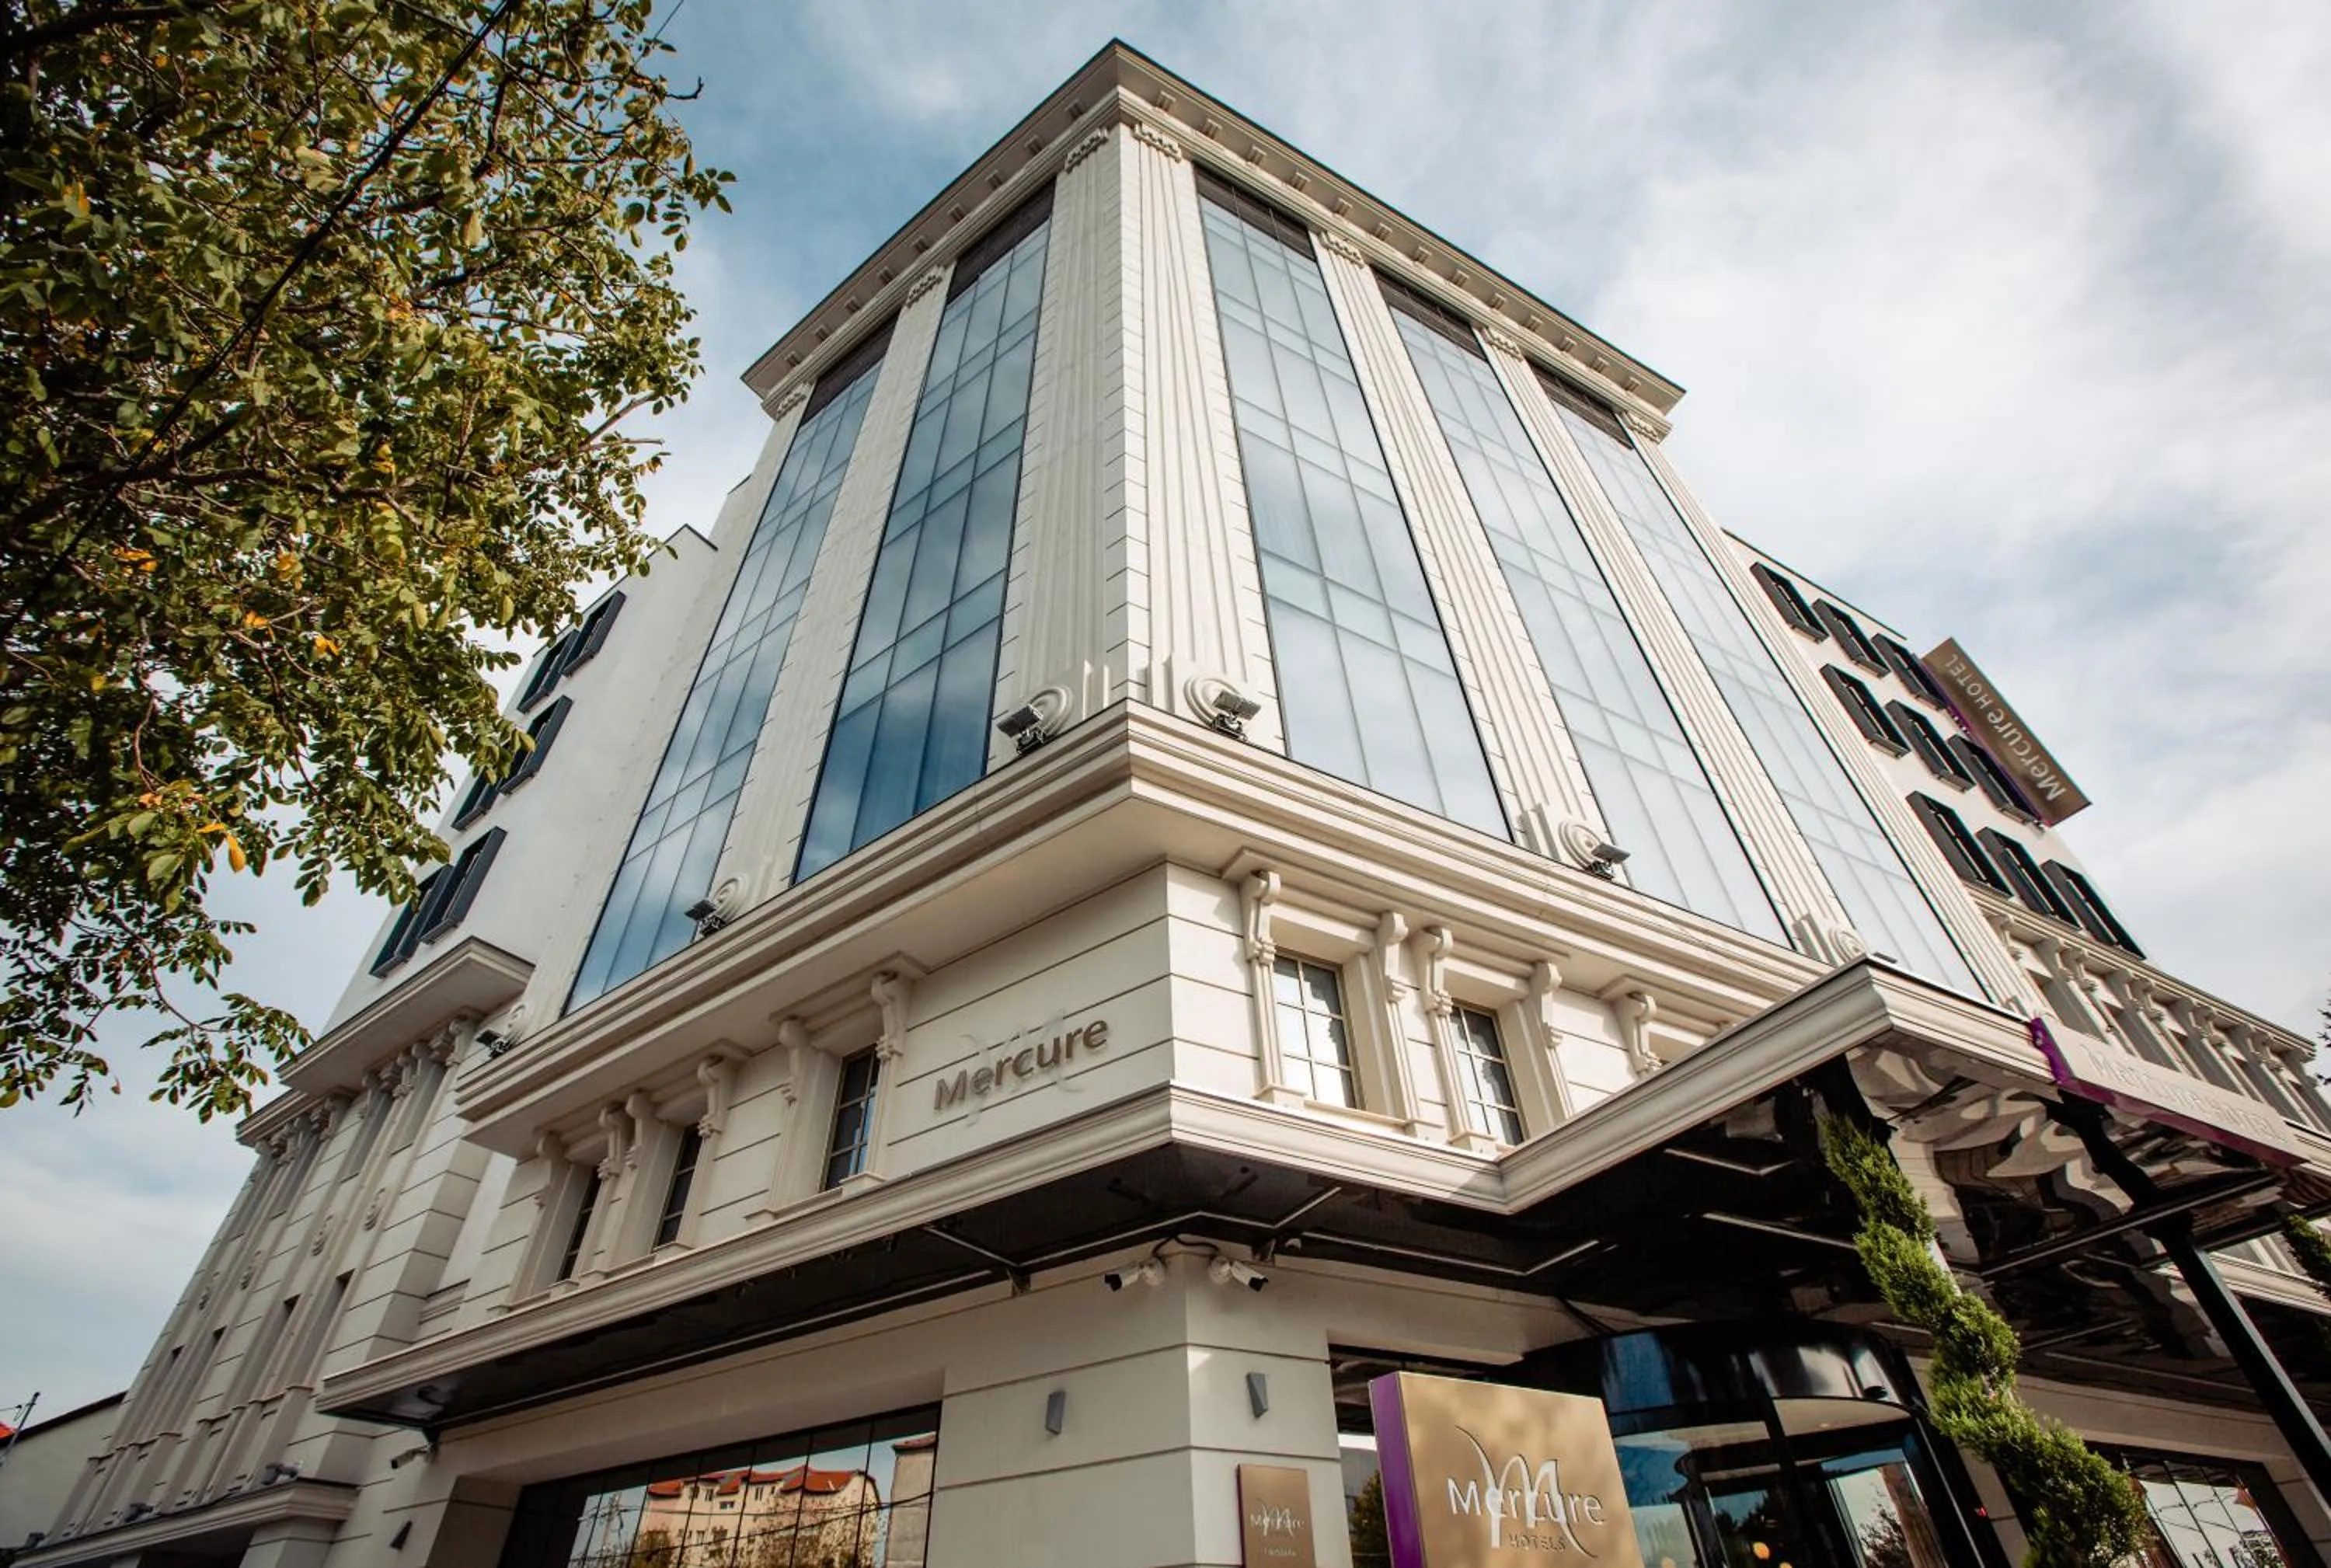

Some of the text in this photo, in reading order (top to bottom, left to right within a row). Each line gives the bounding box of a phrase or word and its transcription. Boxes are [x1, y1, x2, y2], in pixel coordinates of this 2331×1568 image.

[1944, 653, 2067, 801] Mercure HOTEL
[934, 1019, 1109, 1111] Mercure
[1509, 1532, 1566, 1552] HOTELS
